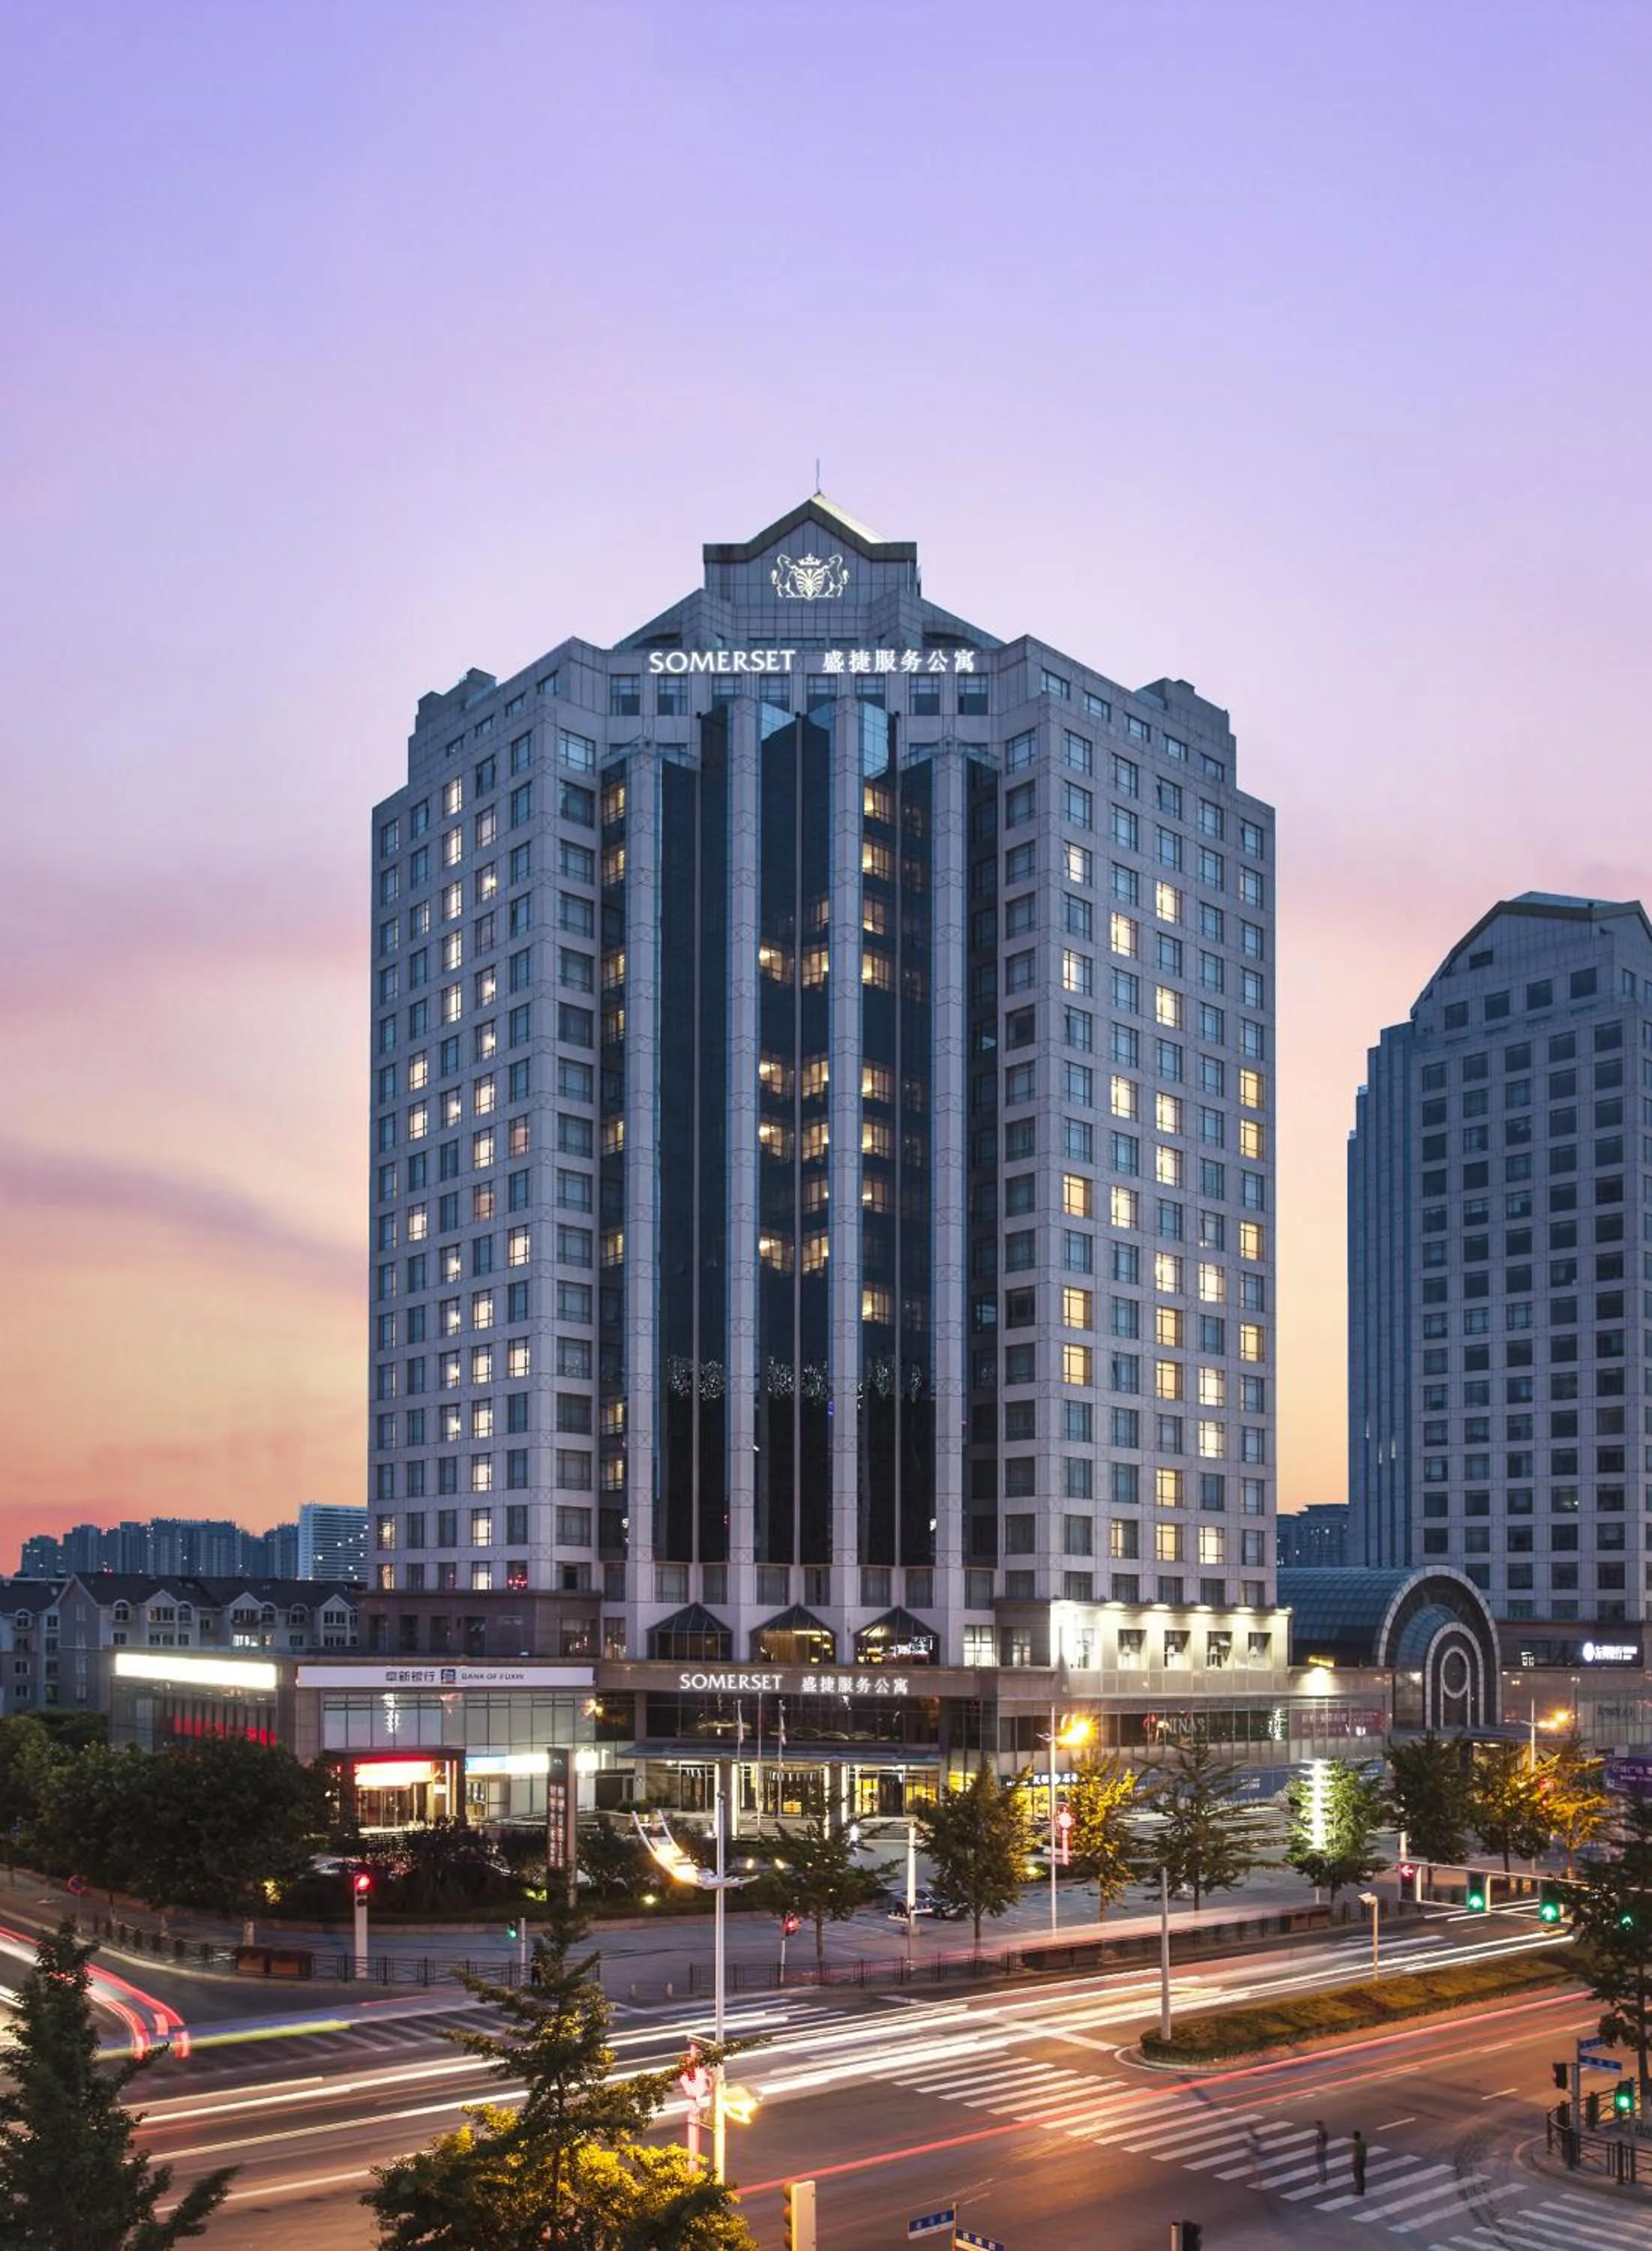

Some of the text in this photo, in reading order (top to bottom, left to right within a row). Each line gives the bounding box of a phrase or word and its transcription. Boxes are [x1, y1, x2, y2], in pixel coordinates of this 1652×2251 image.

[650, 650, 795, 673] SOMERSET
[822, 649, 975, 674] 盛捷服务公寓
[680, 1674, 783, 1690] SOMERSET
[801, 1675, 909, 1694] 盛捷服务公寓
